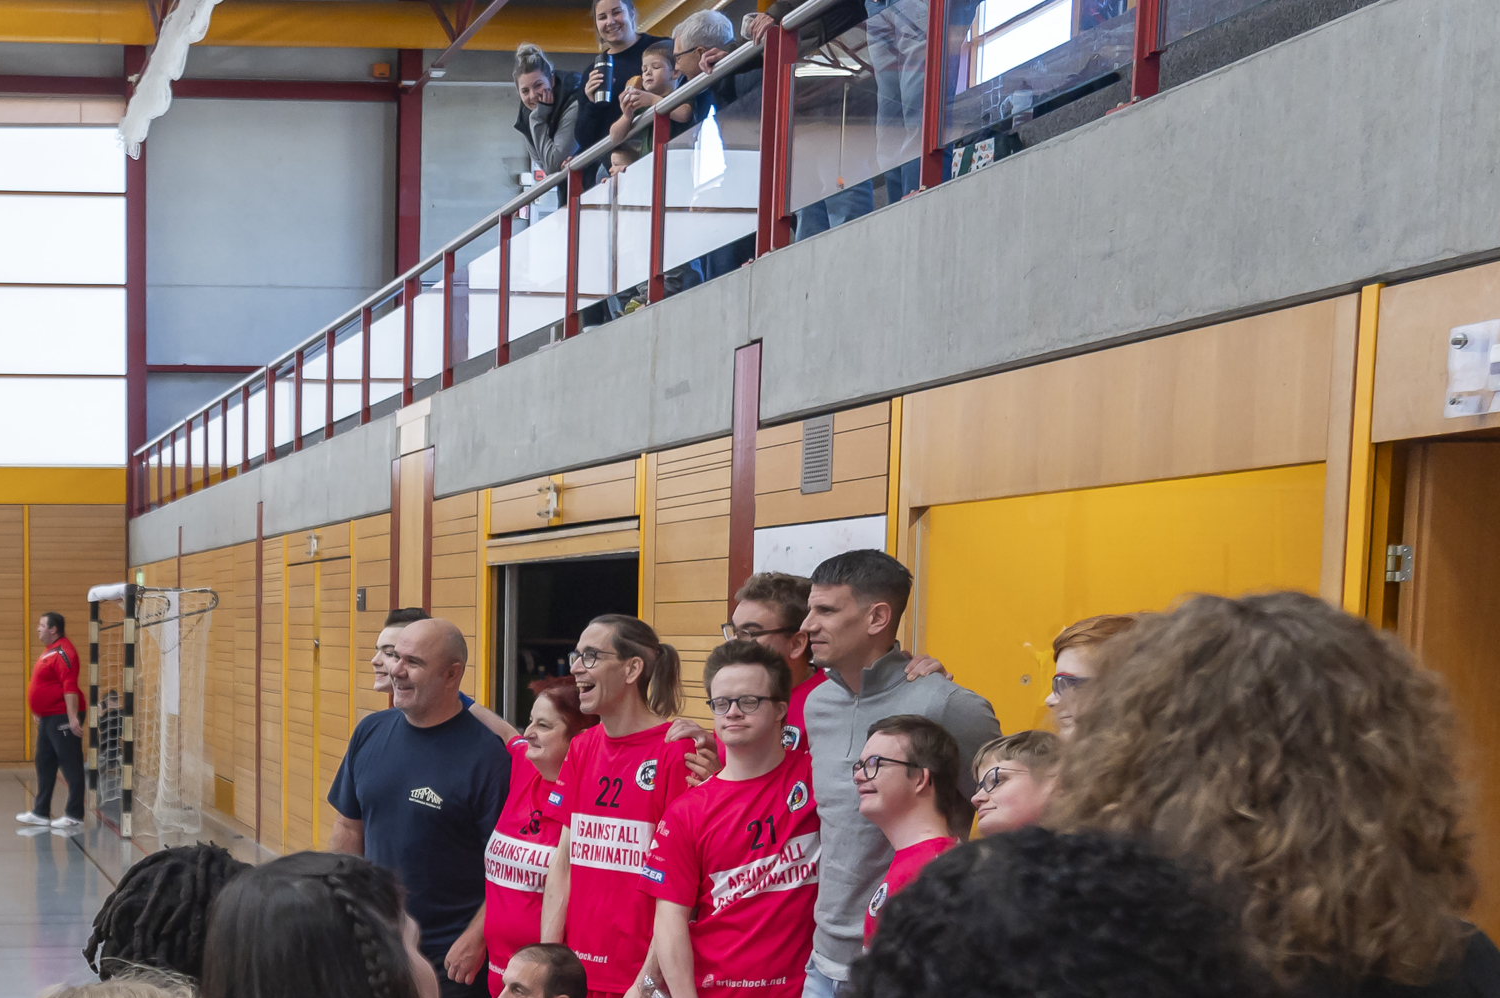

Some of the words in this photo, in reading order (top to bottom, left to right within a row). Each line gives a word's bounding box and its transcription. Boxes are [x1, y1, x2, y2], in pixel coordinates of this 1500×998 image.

[594, 776, 623, 808] 22
[617, 825, 640, 845] ALL
[746, 814, 777, 851] 21
[487, 838, 529, 864] AGAINST
[527, 844, 551, 869] ALL
[779, 842, 806, 866] ALL
[641, 867, 664, 883] ZER
[716, 976, 787, 989] artischock.net
